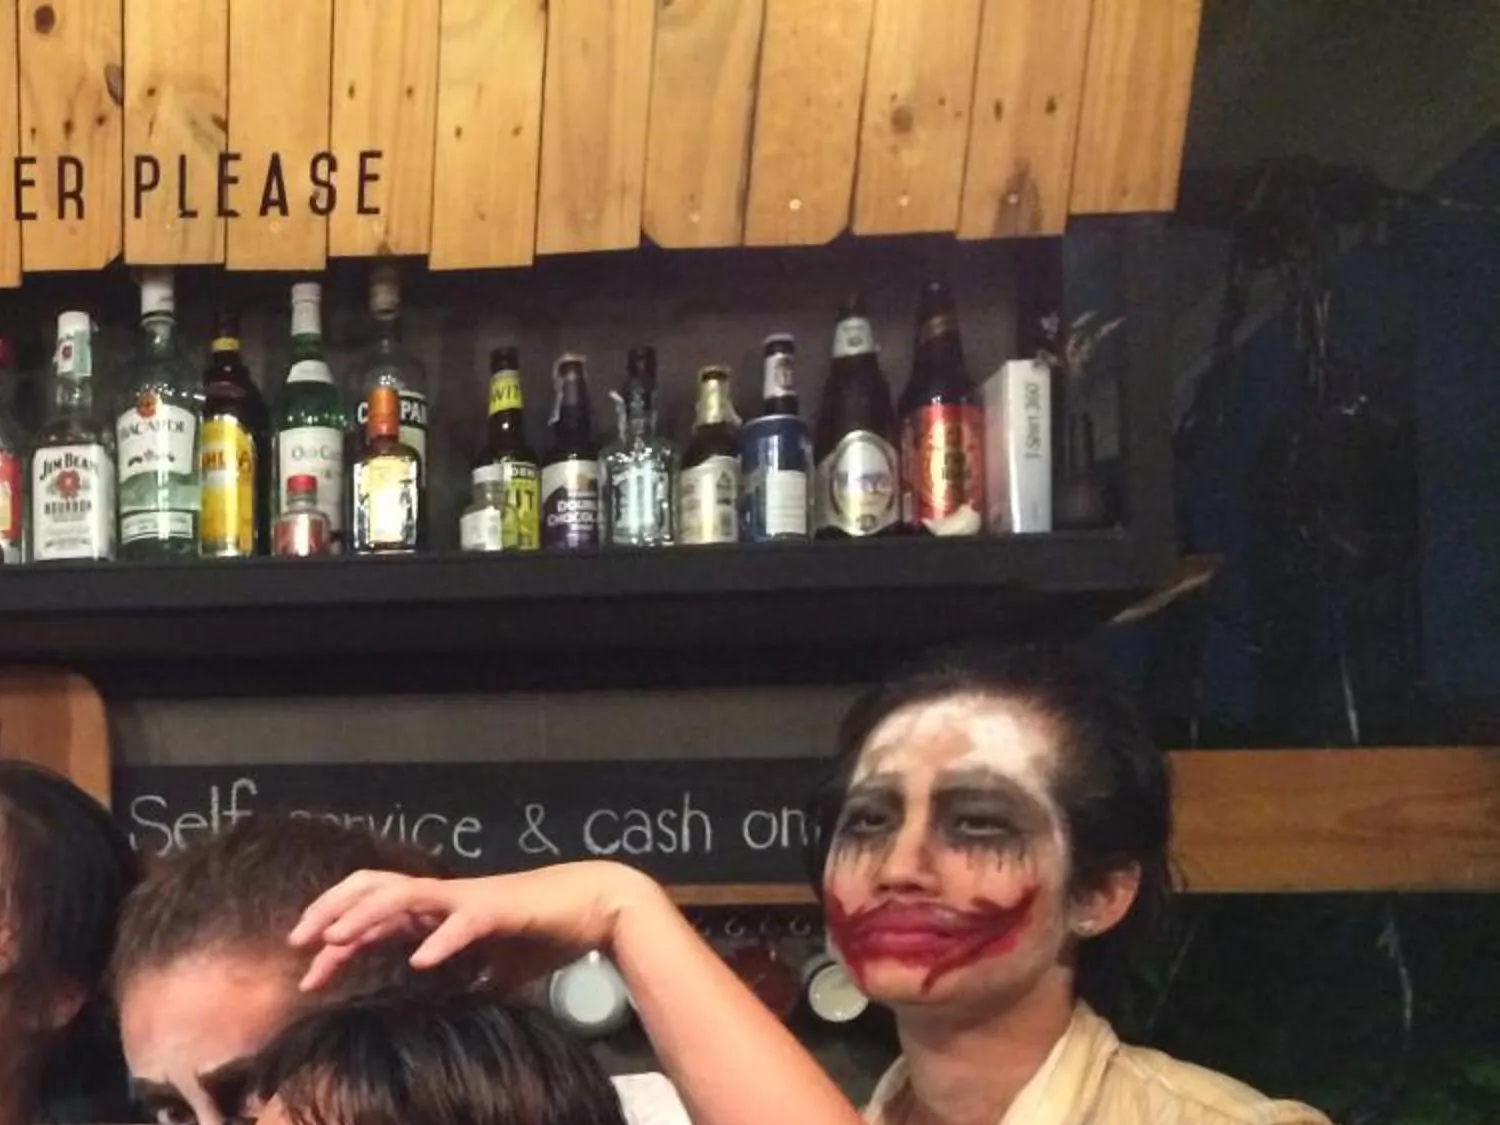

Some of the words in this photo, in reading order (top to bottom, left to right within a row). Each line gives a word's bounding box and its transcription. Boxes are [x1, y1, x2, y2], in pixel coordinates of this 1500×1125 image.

[133, 149, 384, 218] PLEASE
[129, 778, 257, 858] Self
[289, 803, 482, 858] rvice
[518, 803, 560, 855] &
[583, 792, 712, 854] cash
